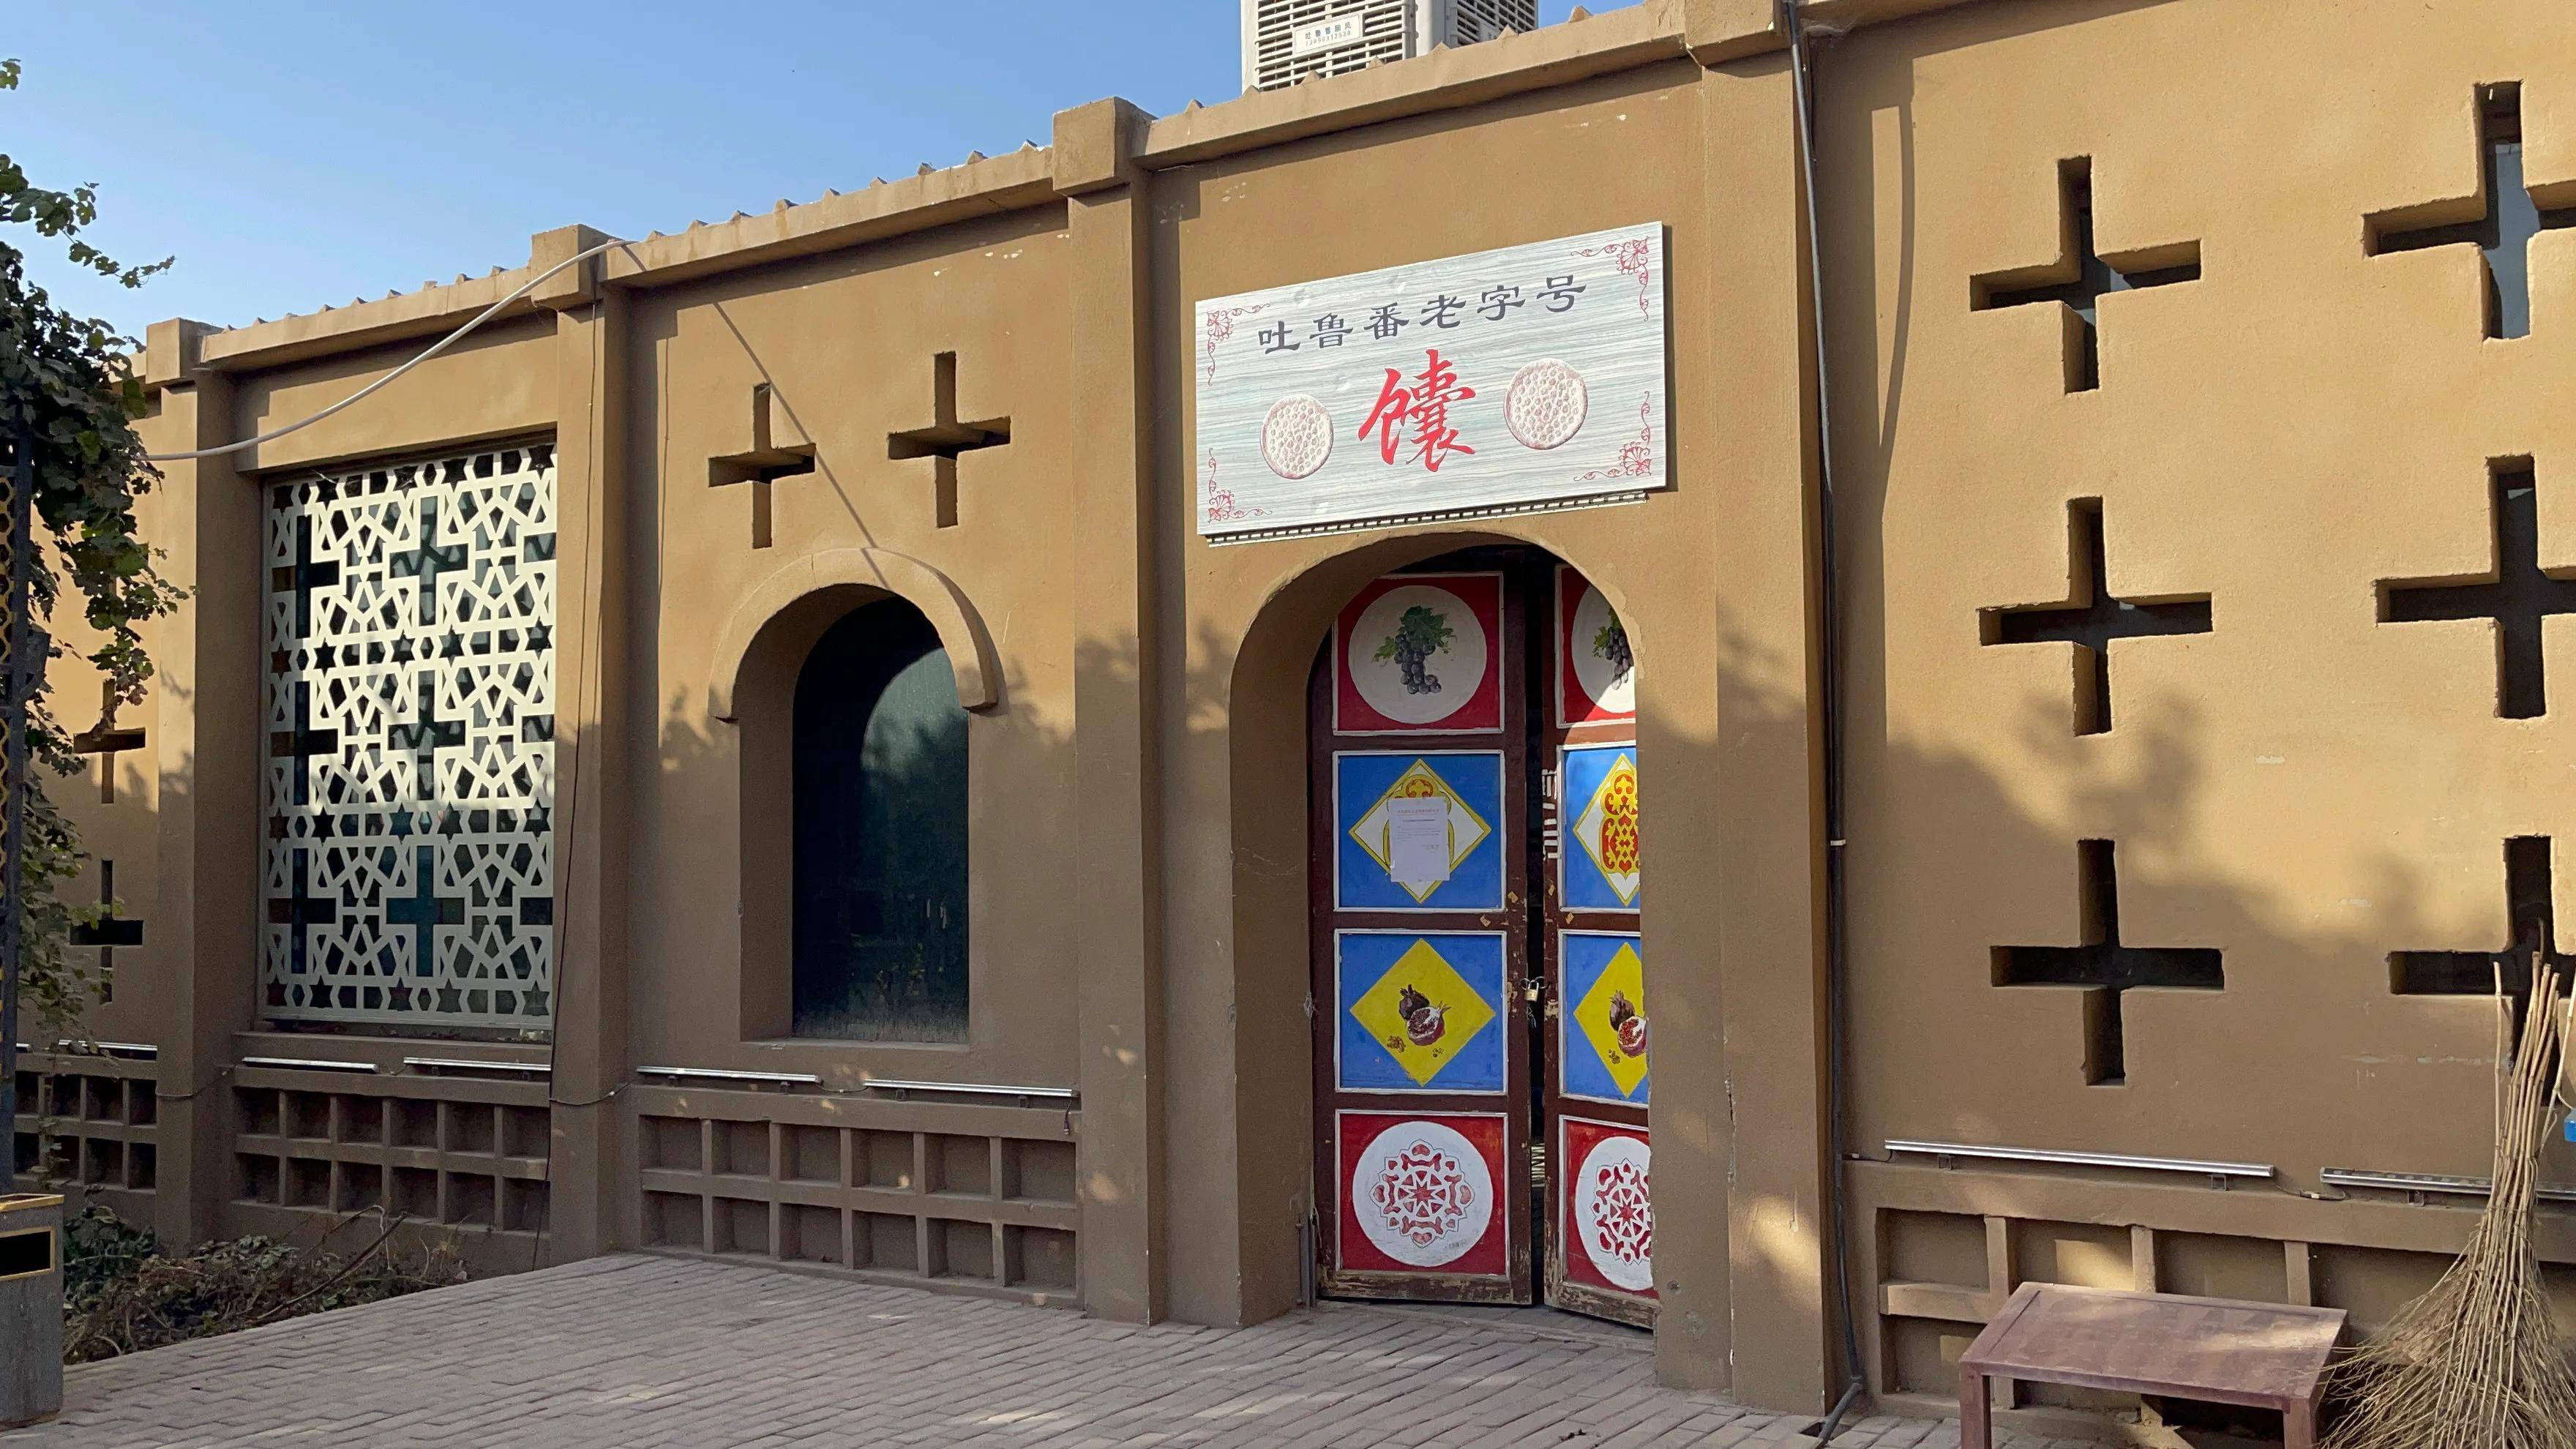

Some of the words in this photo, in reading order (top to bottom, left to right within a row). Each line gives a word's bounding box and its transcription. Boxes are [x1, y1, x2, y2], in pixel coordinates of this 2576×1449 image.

[1258, 274, 1587, 355] 吐鲁番老字号
[1358, 348, 1476, 472] 馕
